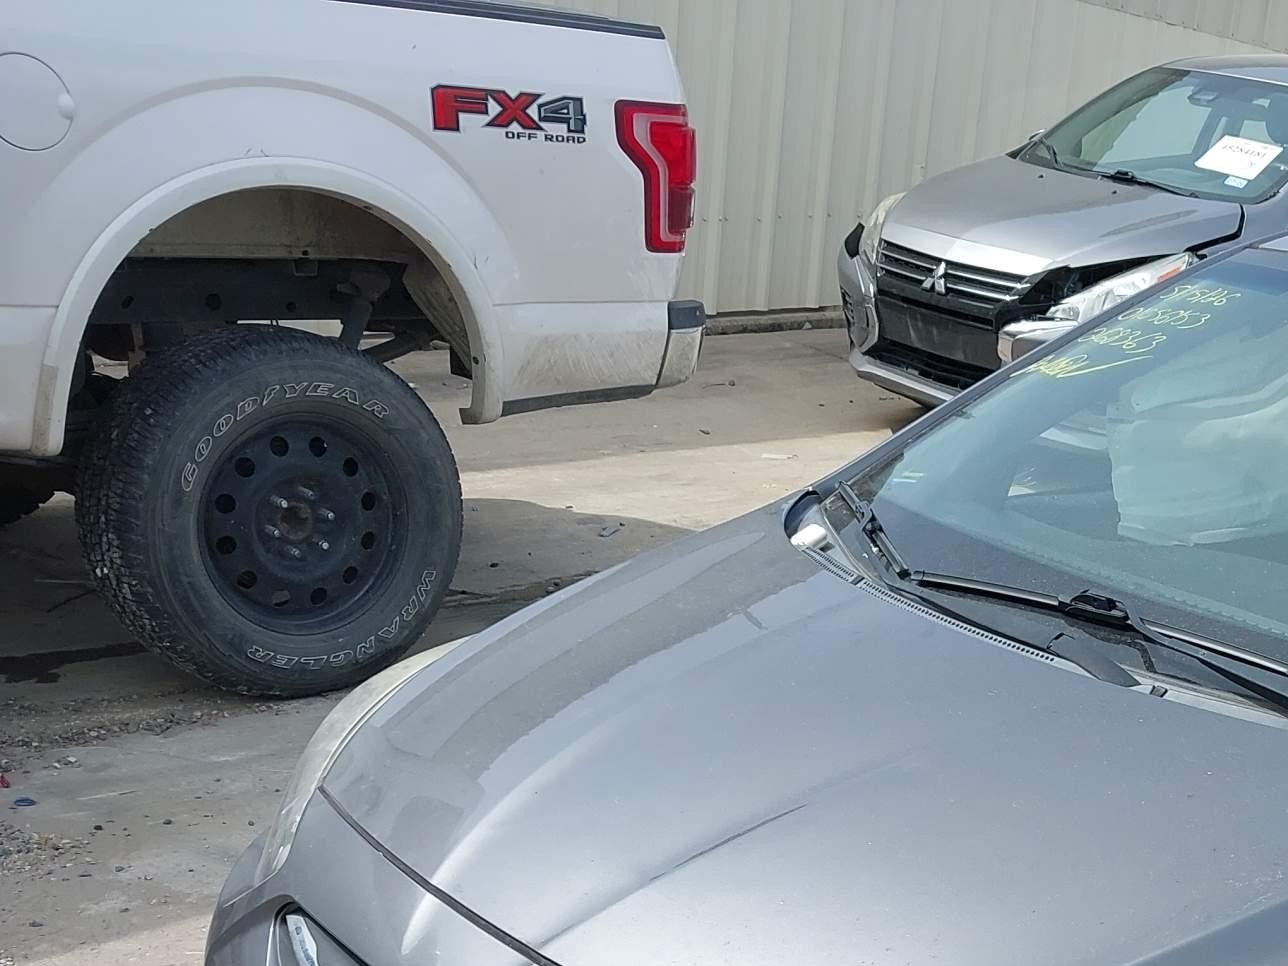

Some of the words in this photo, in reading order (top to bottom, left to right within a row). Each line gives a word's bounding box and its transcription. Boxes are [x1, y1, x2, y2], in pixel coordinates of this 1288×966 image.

[430, 84, 587, 134] FX4
[505, 130, 538, 141] OFF
[544, 132, 587, 144] ROAD
[182, 382, 389, 491] GOODYEAR
[247, 569, 437, 670] WRANGLER
